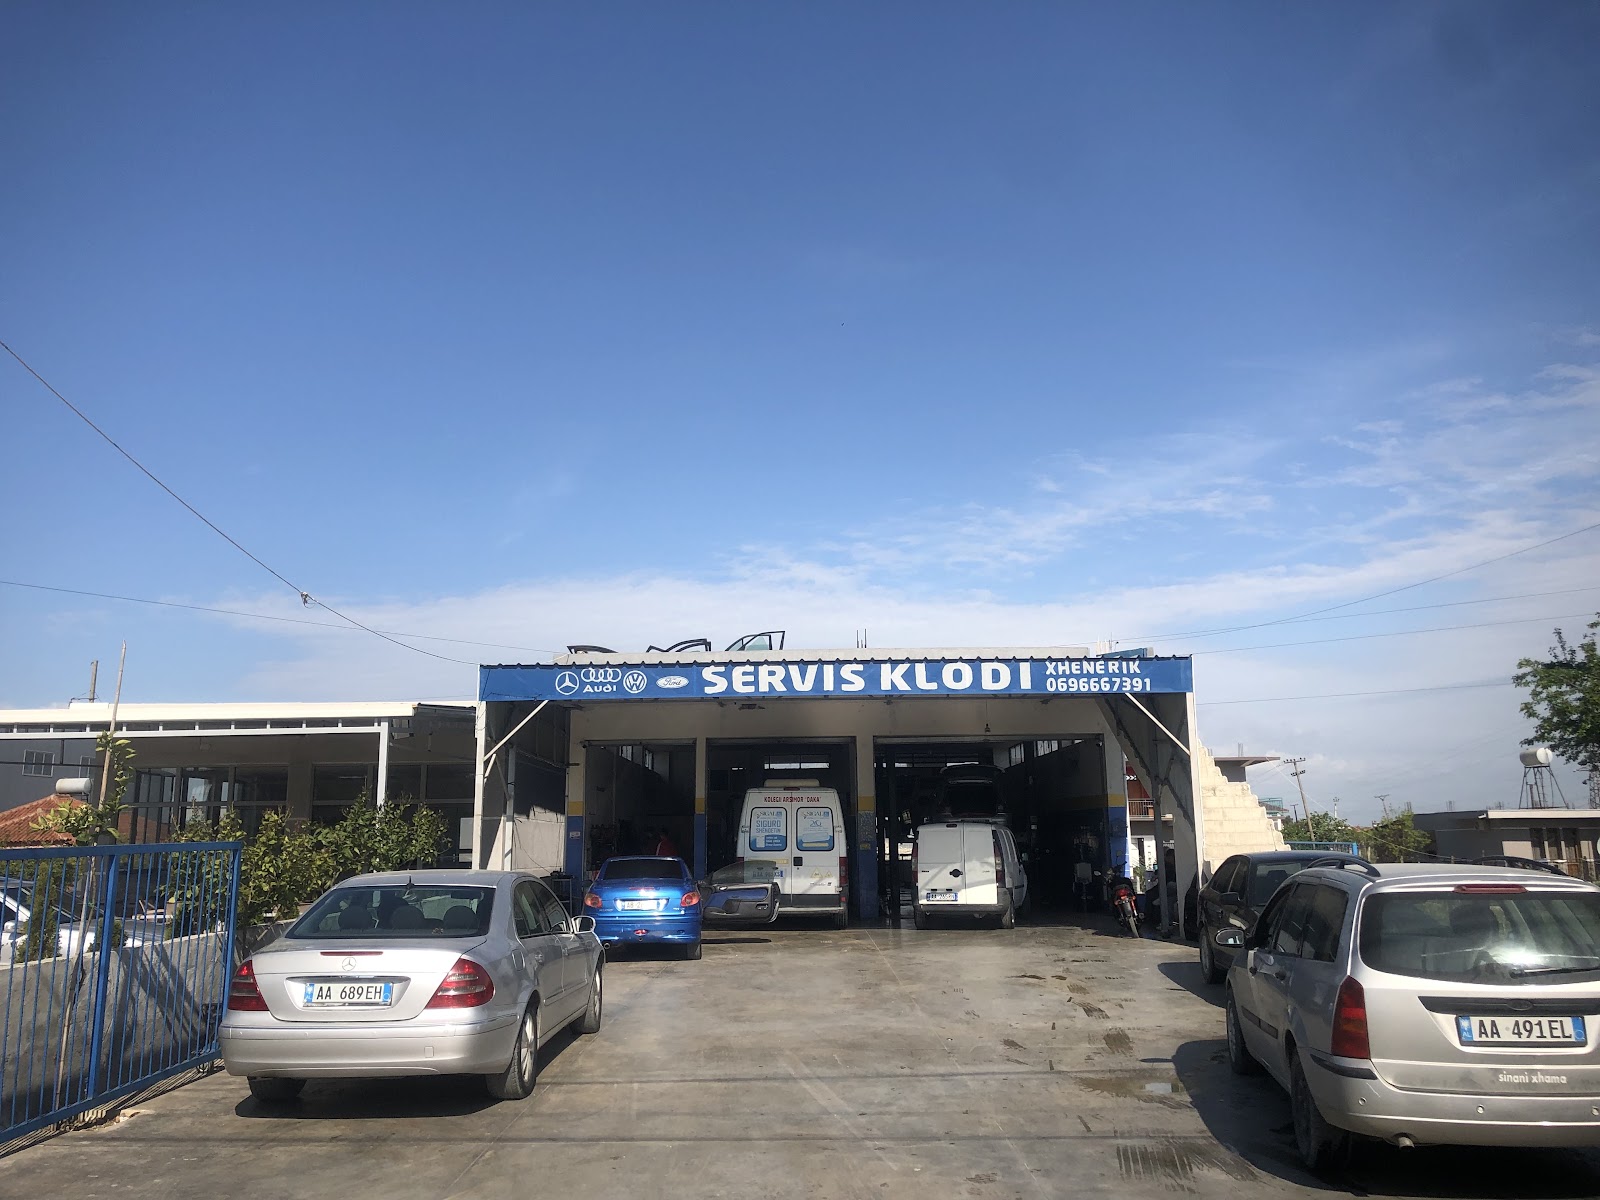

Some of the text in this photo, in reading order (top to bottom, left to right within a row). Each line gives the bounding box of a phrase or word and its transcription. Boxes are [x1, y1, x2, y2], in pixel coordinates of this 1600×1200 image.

[1045, 661, 1141, 675] XHENERIK
[702, 662, 1032, 694] SERVIS KLODI
[1046, 677, 1151, 692] 0696667391
[316, 986, 383, 1000] AA 689EH
[1478, 1020, 1572, 1039] AA 491EL
[1498, 1071, 1567, 1083] sinani xhama
